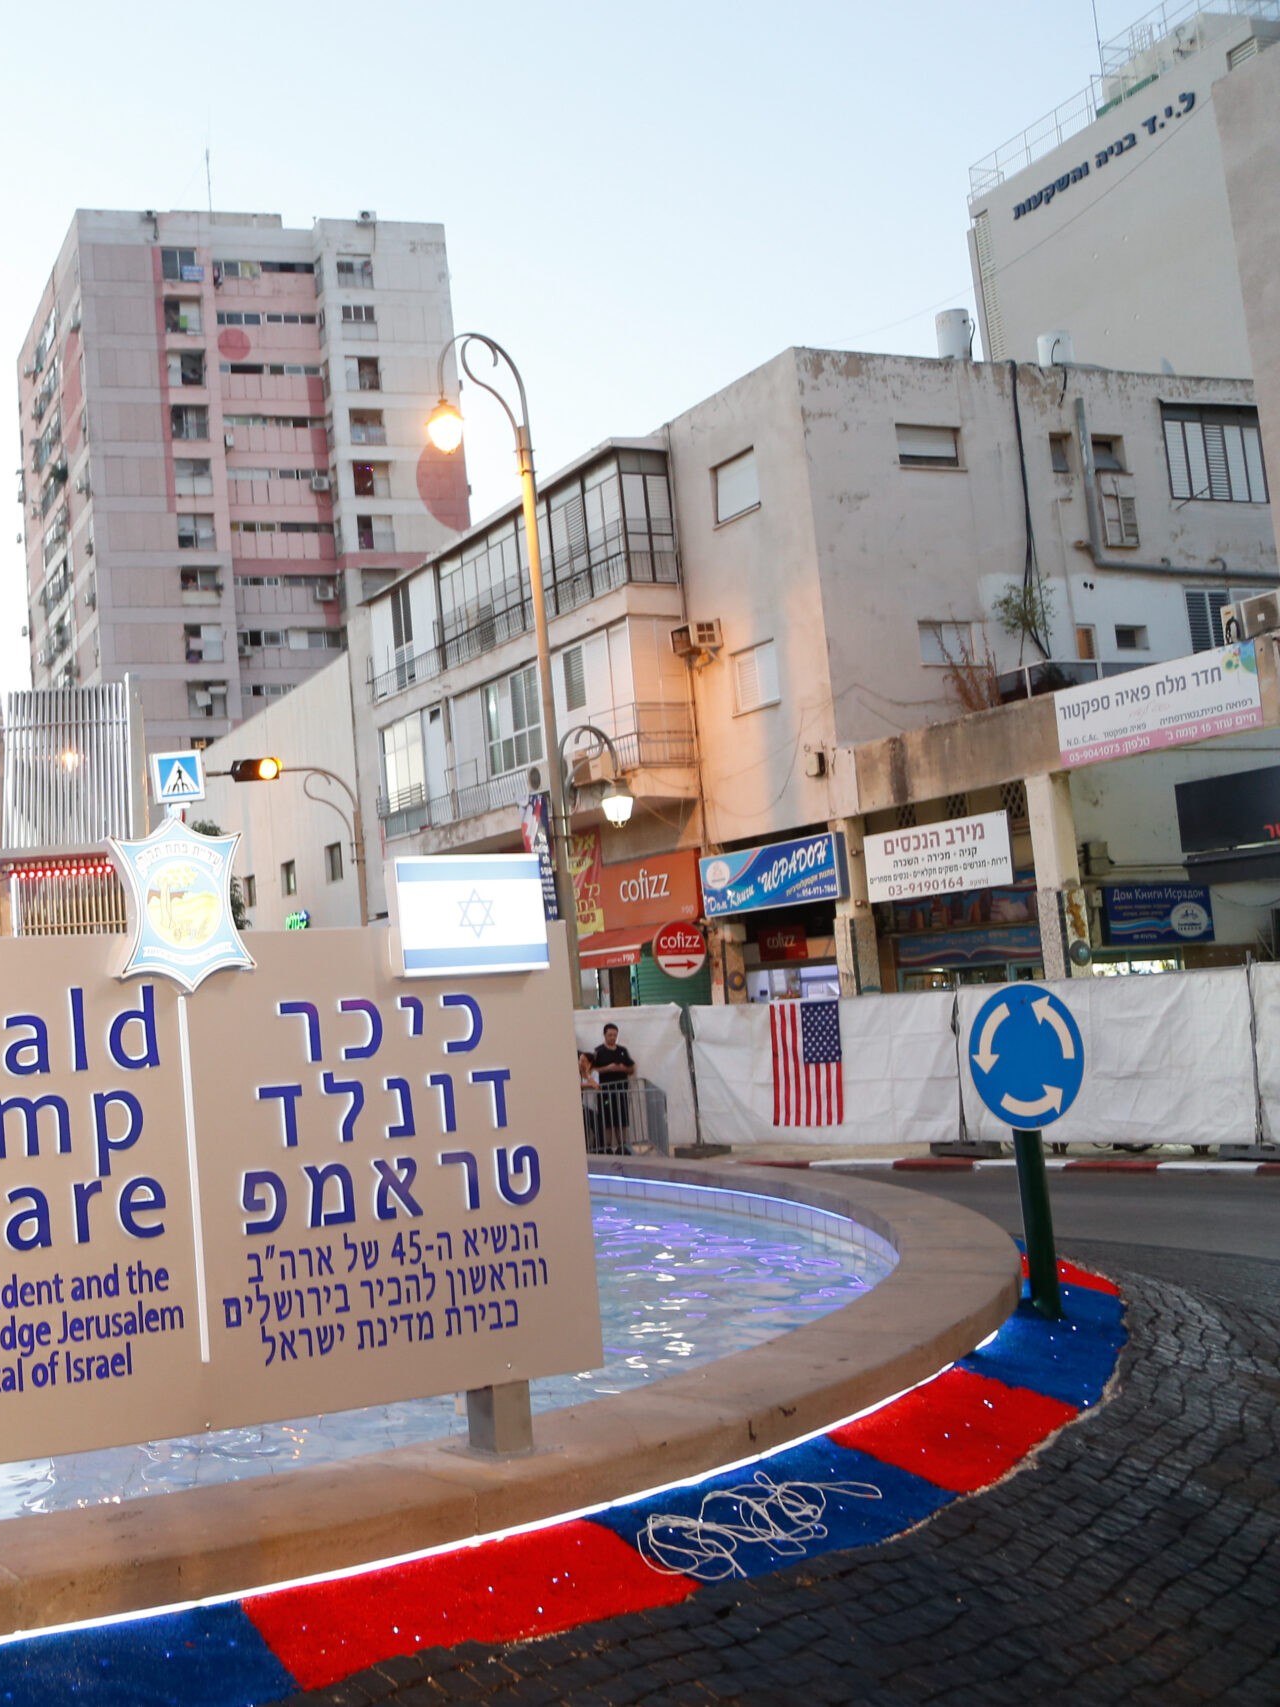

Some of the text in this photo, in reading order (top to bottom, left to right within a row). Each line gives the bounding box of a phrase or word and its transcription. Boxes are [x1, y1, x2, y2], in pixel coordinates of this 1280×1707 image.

[1095, 132, 1137, 169] בניה
[1012, 161, 1090, 221] והשקעות
[1156, 675, 1187, 697] מלח
[1192, 666, 1222, 687] חדר
[1059, 695, 1110, 721] ספקטור
[1115, 685, 1151, 708] פאיה
[884, 822, 985, 856] מירב הנכסים
[893, 847, 977, 869] קניה מכירה השכרה
[938, 865, 959, 876] משקים
[963, 860, 986, 871] מגרשים
[991, 857, 1008, 866] דירות
[620, 868, 671, 903] cofizz
[888, 876, 964, 897] 03-9190164
[1113, 887, 1204, 902] Дом Книги Исрадон
[660, 931, 701, 949] cofizz
[277, 994, 482, 1061] כיכר
[259, 1070, 510, 1146] דונלד
[244, 1146, 539, 1234] טראמפ
[344, 1233, 378, 1271] של
[392, 1231, 451, 1264] ה-45
[464, 1222, 536, 1256] הנשיא
[72, 1265, 119, 1298] and
[127, 1261, 168, 1294] the
[224, 1259, 549, 1327] והראשון להכיר בירושלים
[58, 1302, 183, 1344] Jerusalem
[262, 1300, 517, 1364] כבירת מדינת ישראל
[32, 1351, 58, 1387] of
[66, 1344, 132, 1382] Israel
